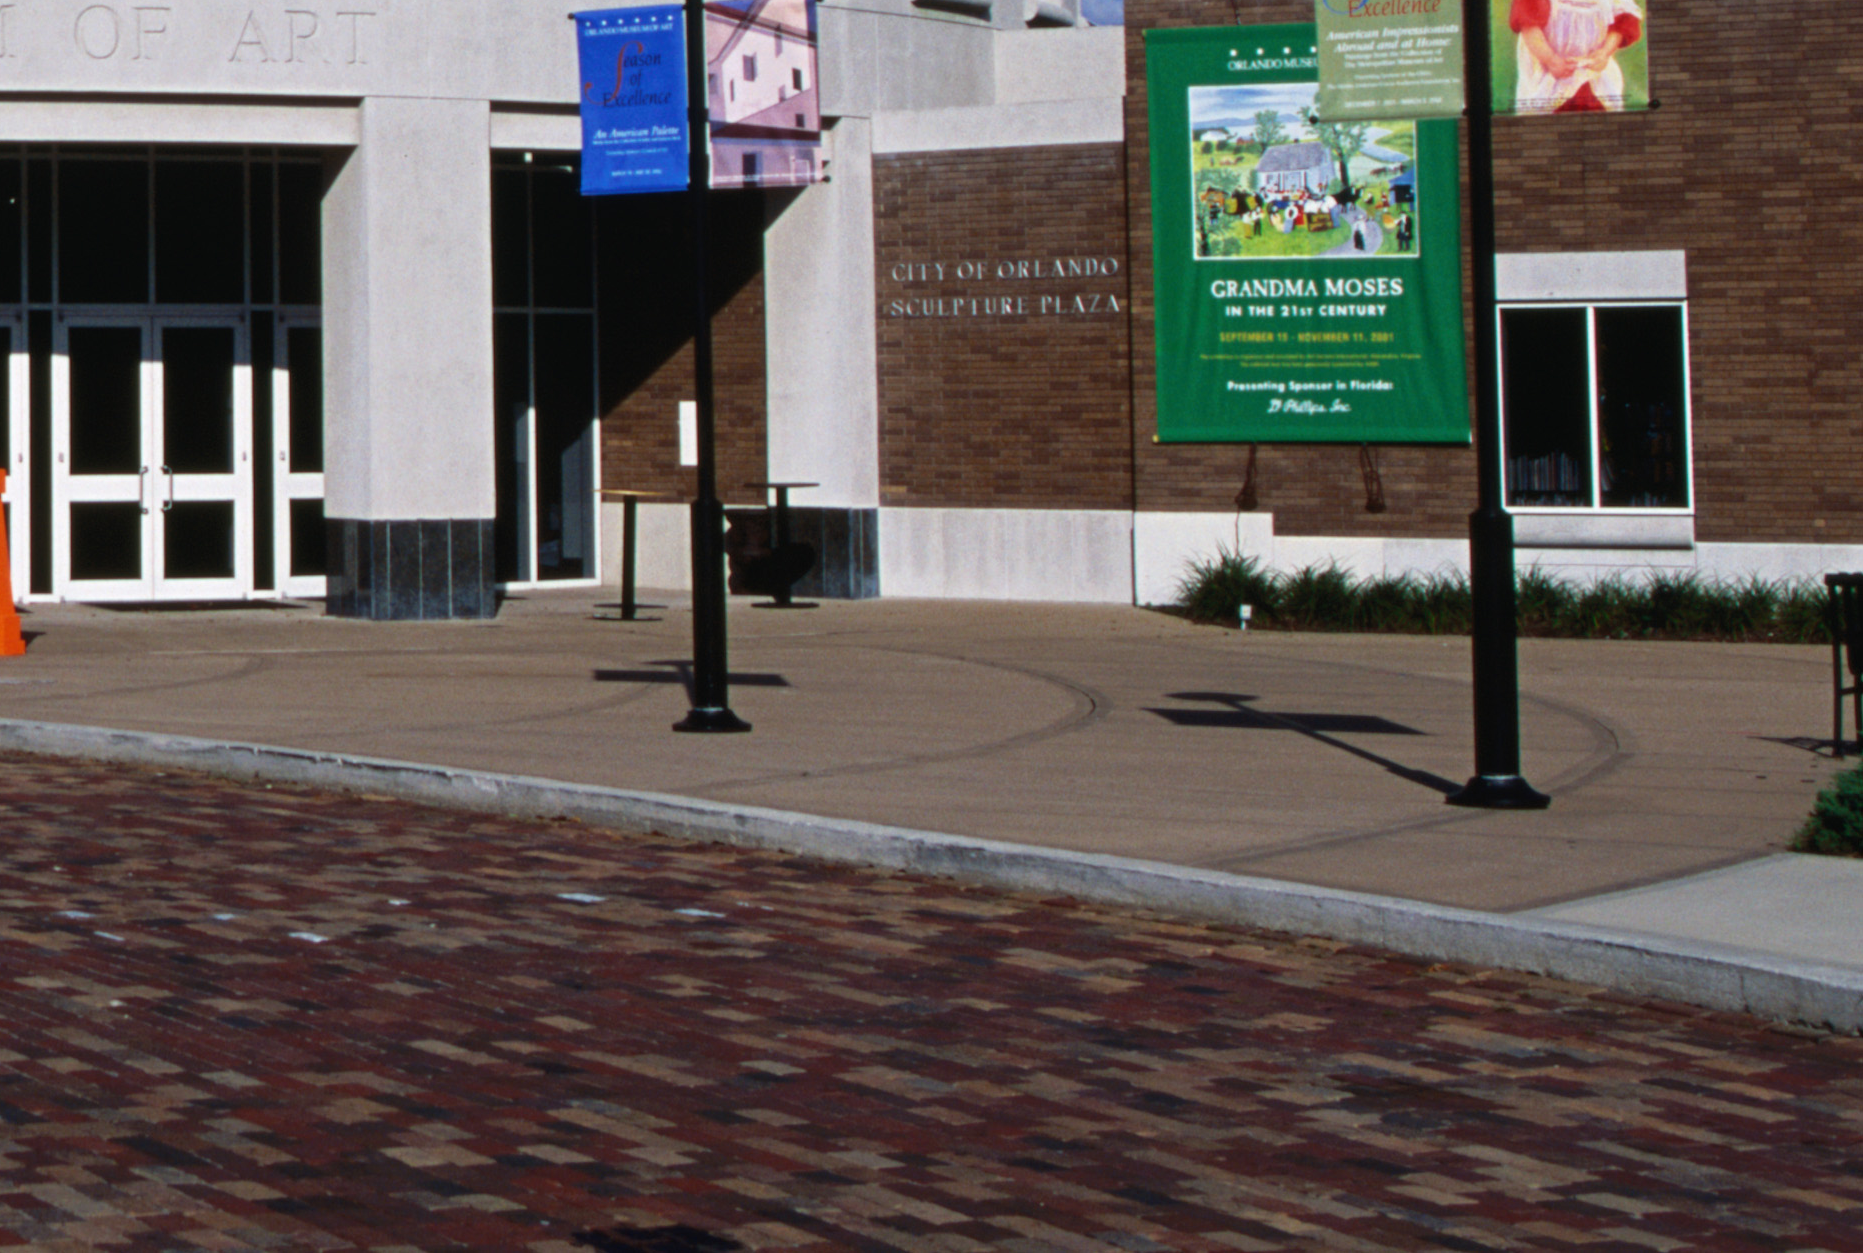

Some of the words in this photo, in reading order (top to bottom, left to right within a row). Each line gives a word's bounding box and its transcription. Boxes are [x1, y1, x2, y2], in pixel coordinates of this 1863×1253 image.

[74, 4, 172, 60] OF
[228, 9, 377, 65] ART
[1326, 29, 1379, 41] American
[1381, 24, 1459, 39] Impressionists
[1333, 40, 1376, 53] Abroad
[1376, 38, 1399, 50] and
[1400, 38, 1415, 49] at
[1227, 58, 1283, 71] ORLANDO
[629, 68, 642, 87] of
[602, 89, 672, 108] Excellence
[608, 127, 649, 139] American
[891, 262, 947, 282] CITY
[957, 261, 987, 280] OF
[997, 257, 1120, 279] ORLANDO
[1210, 278, 1318, 298] GRANDMA
[1324, 277, 1404, 297] MOSES
[890, 297, 1029, 317] SCULPTURE
[1040, 293, 1121, 315] PLAZA
[1225, 305, 1242, 317] IN
[1248, 305, 1275, 317] THE
[1318, 303, 1387, 317] CENTURY
[1219, 331, 1275, 343] SEPTEMBER
[1297, 331, 1351, 343] NOVEMBER
[1370, 331, 1395, 343] 2001
[1226, 379, 1286, 394] Presenting
[1288, 379, 1334, 393] Sponsor
[1335, 378, 1348, 391] in
